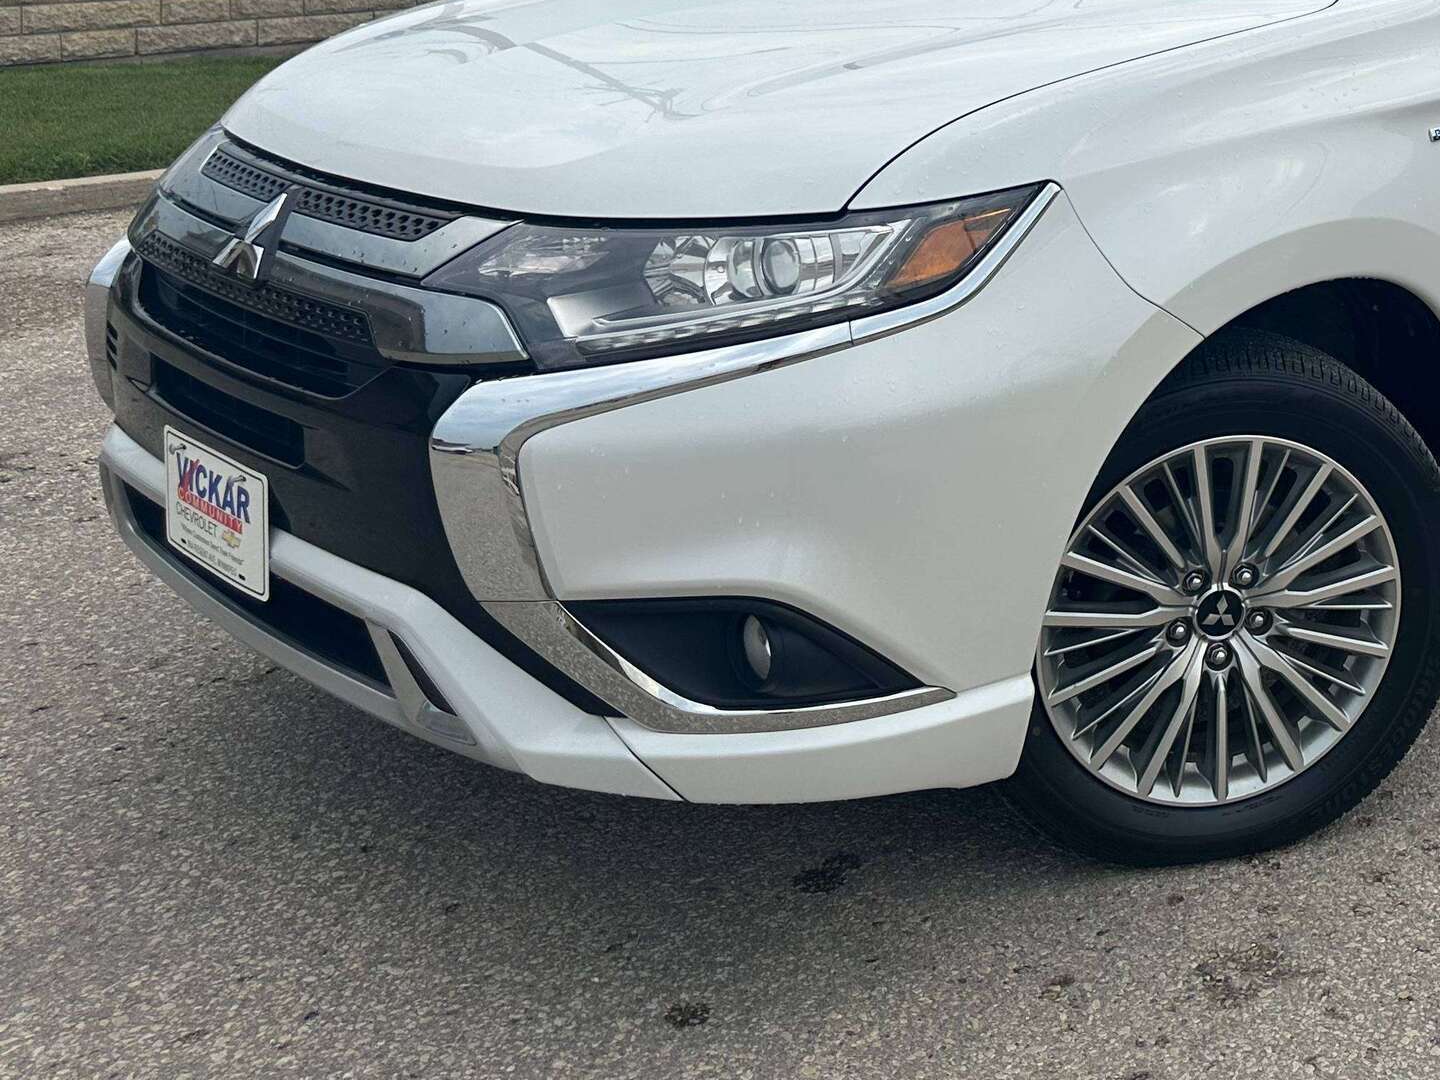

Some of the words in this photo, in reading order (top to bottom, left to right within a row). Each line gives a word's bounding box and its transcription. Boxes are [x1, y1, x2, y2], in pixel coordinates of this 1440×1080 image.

[175, 452, 251, 524] VICKAR
[177, 487, 244, 535] COMMUNITY
[175, 500, 218, 537] CHEVROLET
